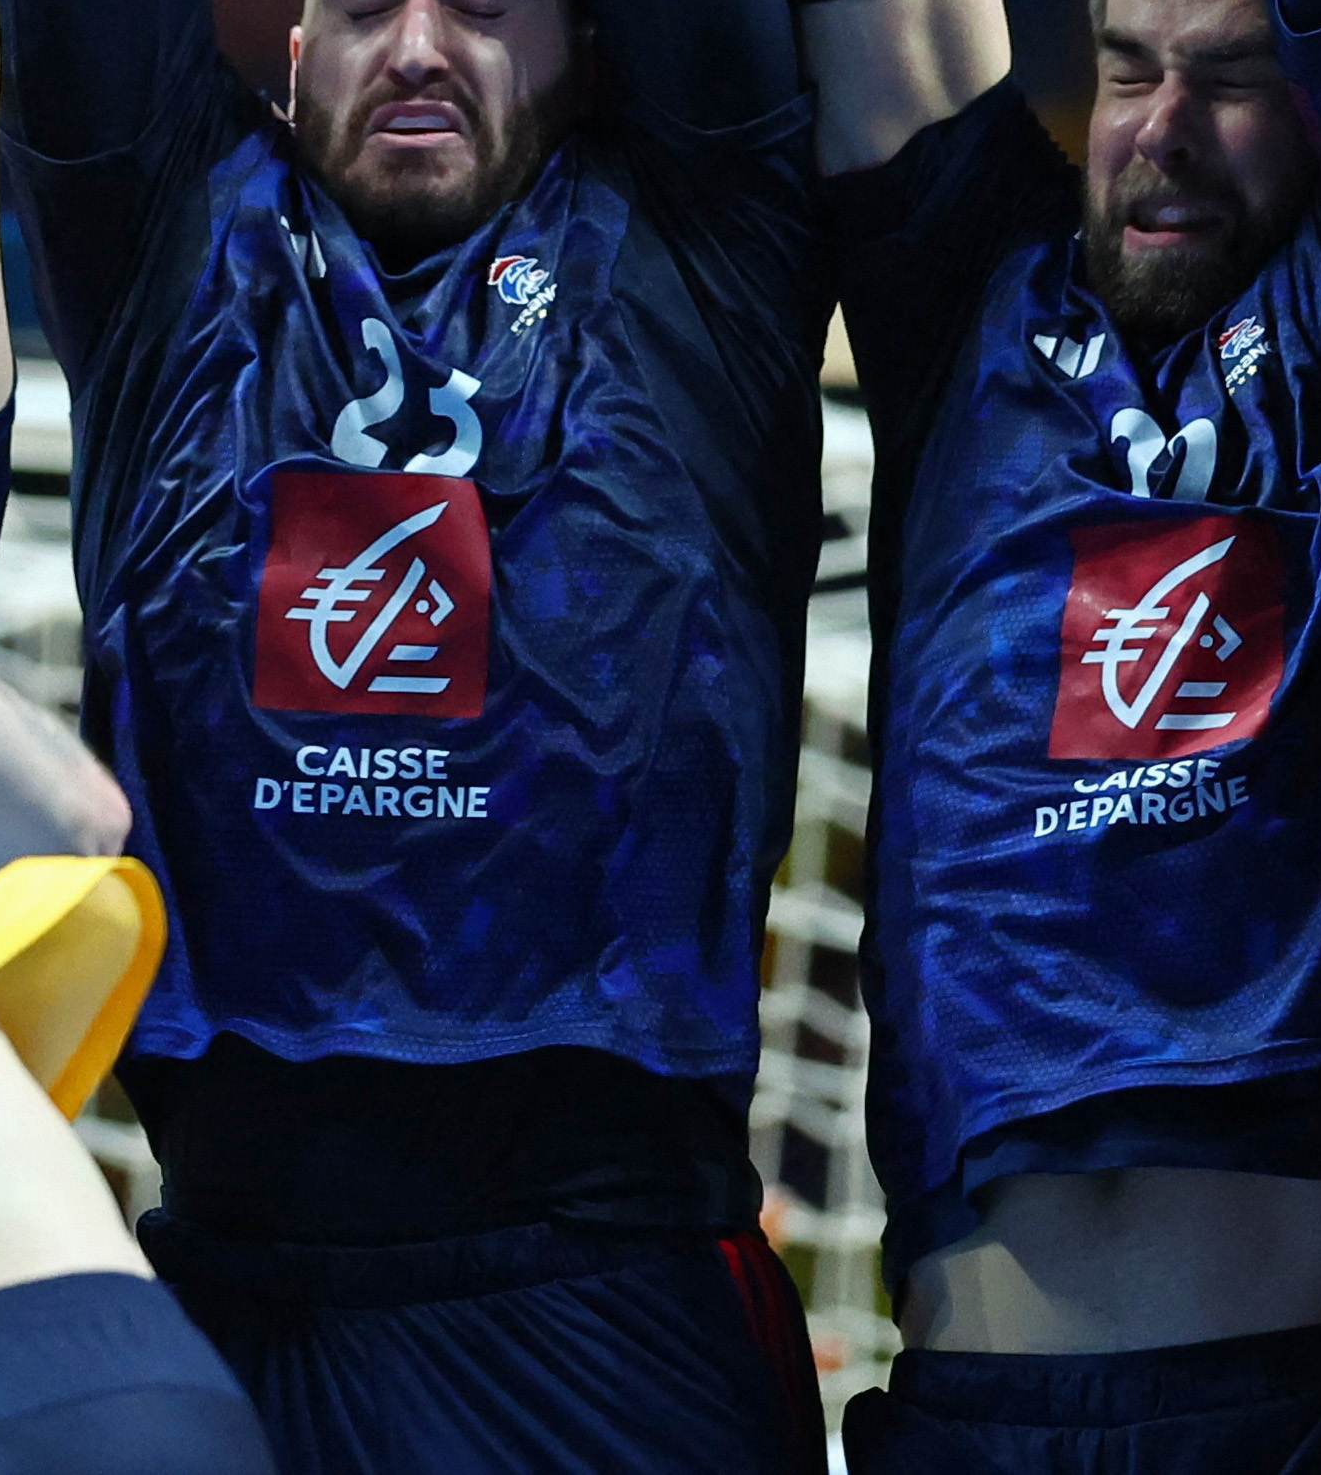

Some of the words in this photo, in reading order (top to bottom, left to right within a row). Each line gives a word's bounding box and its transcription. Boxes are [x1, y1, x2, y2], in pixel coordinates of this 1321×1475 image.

[296, 745, 451, 780] CAISSE
[254, 777, 491, 818] D'EPARGNE
[1033, 775, 1249, 838] D'EPARGNE
